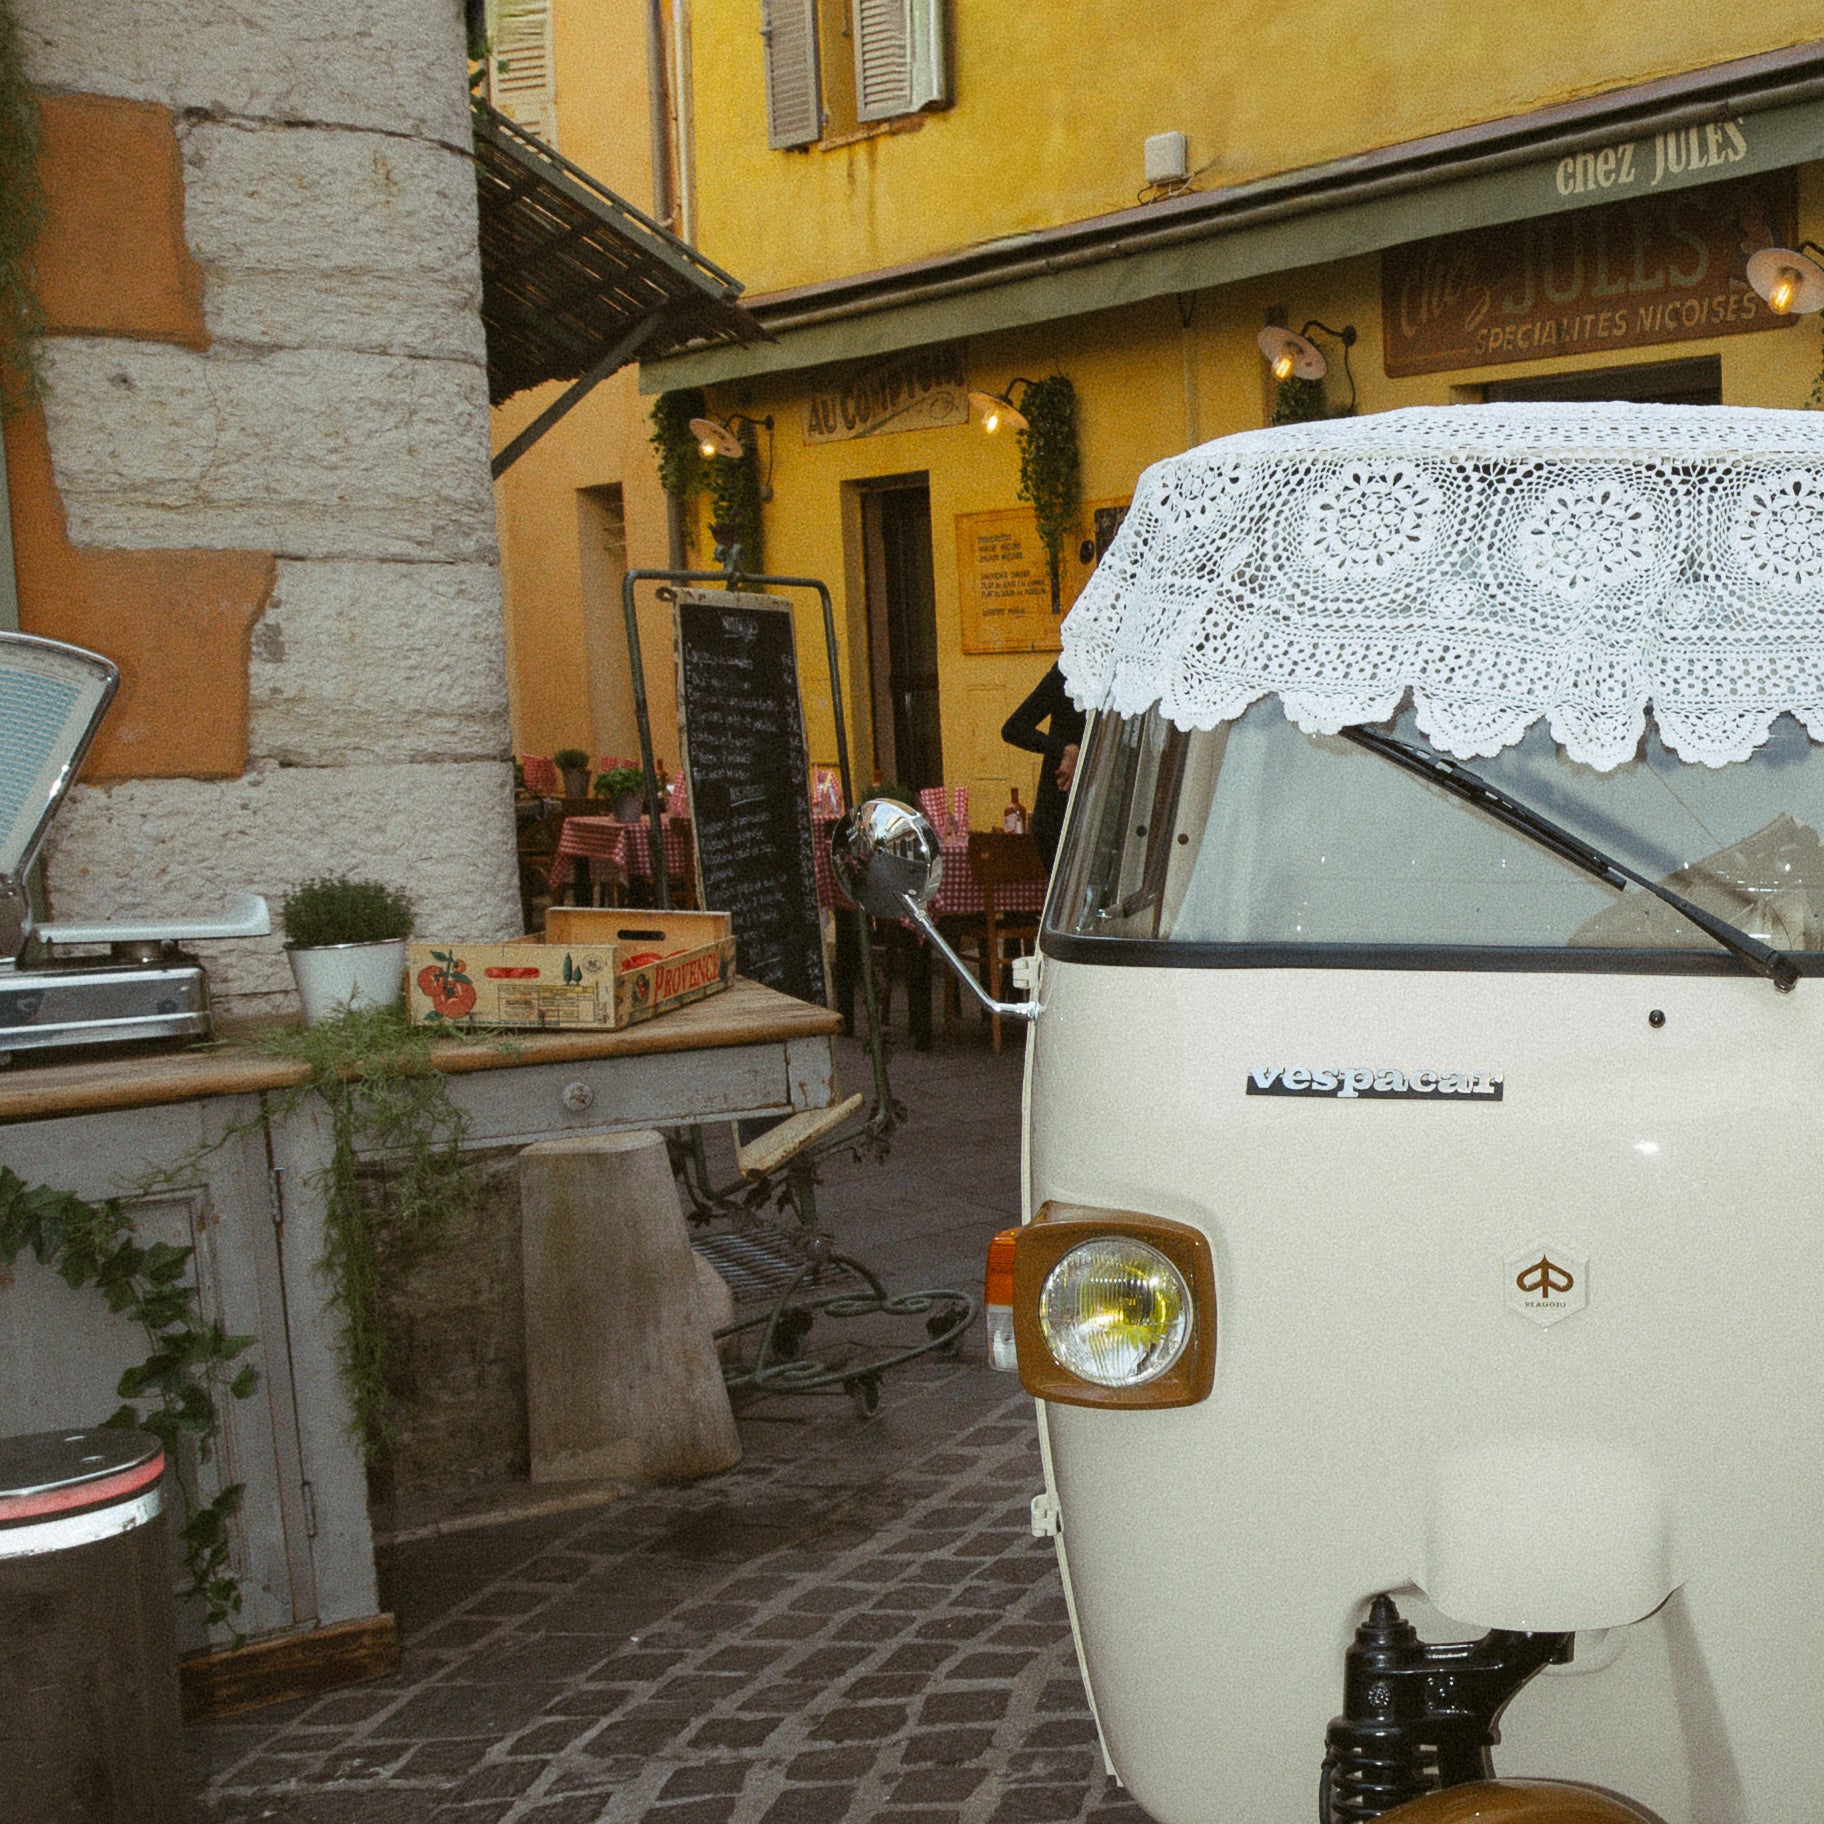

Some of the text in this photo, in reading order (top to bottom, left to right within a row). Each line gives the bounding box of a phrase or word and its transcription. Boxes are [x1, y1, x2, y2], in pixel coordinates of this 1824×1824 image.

[1651, 117, 1747, 186] JULES
[1500, 203, 1708, 314] JULES
[808, 394, 838, 436] AU
[1248, 1066, 1504, 1098] vespacar
